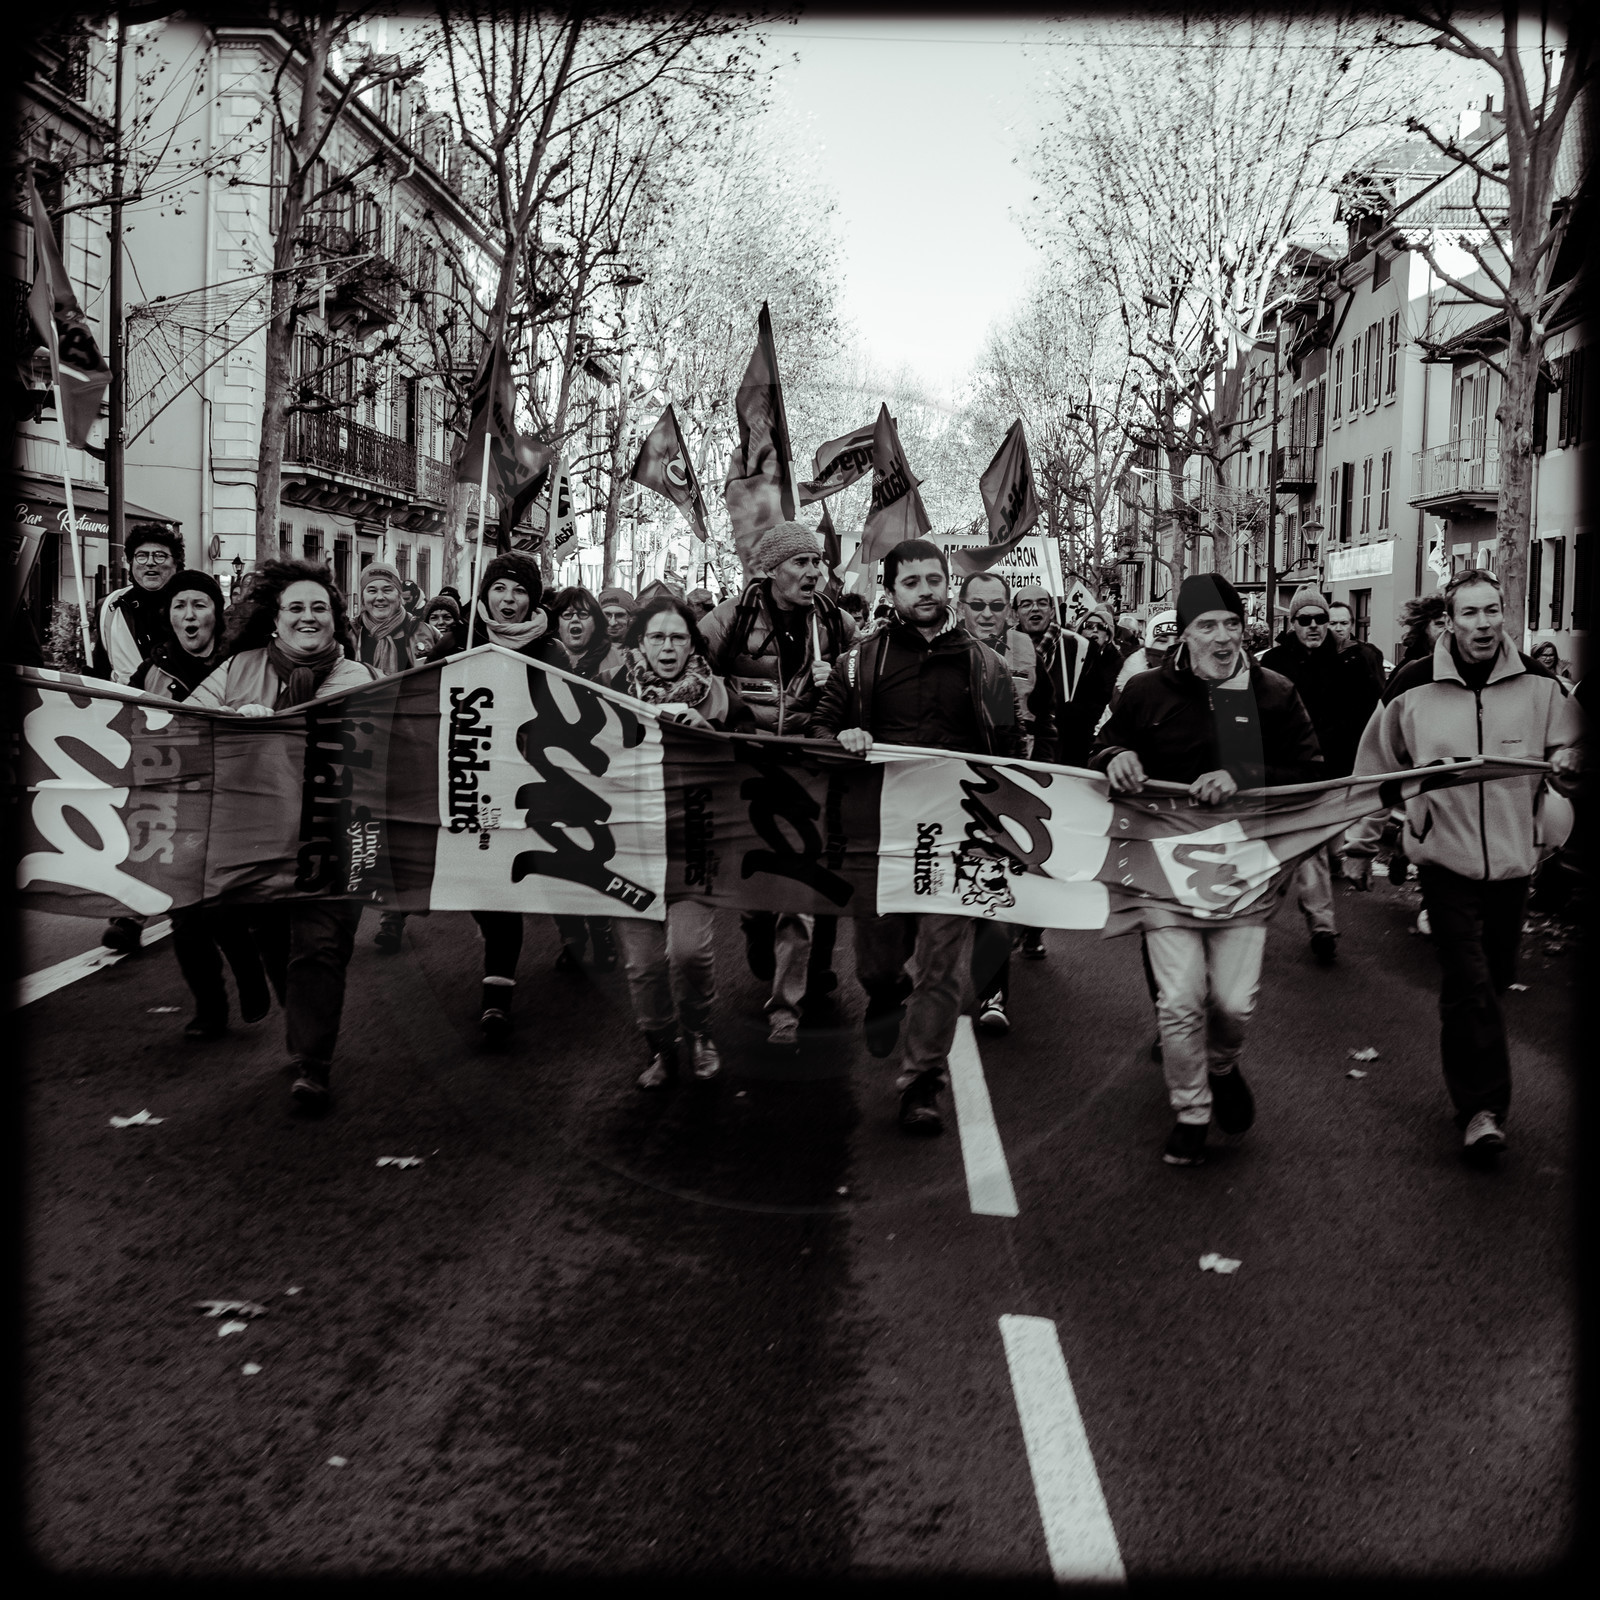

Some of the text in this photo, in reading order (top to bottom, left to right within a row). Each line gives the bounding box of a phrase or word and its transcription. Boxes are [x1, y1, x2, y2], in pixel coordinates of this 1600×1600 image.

[14, 502, 110, 534] Bar Rstaura
[346, 820, 367, 893] syndicale
[365, 820, 382, 870] Union
[605, 877, 648, 907] PTT
